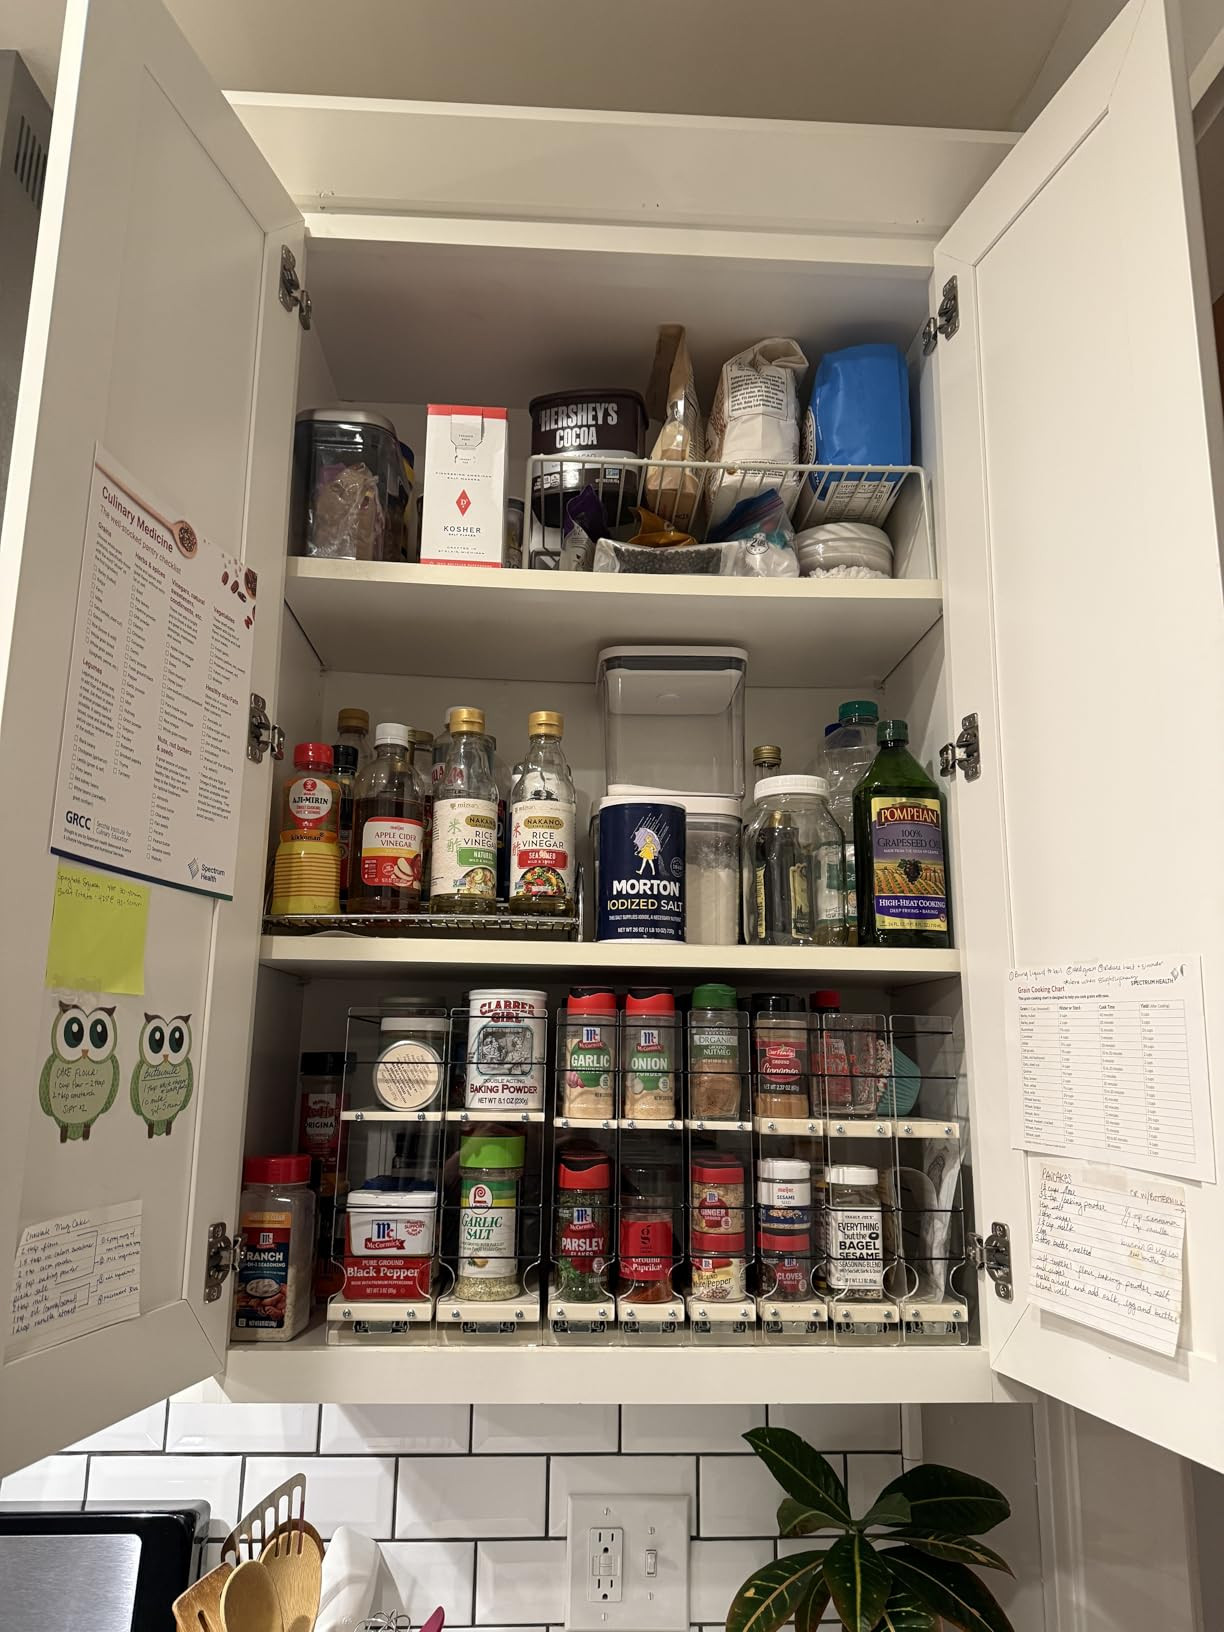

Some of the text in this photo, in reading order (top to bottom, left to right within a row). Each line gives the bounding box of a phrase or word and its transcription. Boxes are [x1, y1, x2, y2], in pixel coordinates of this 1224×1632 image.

[540, 403, 618, 432] HERSHEY'S
[556, 427, 597, 449] COCOA
[102, 486, 174, 553] Culinary Medicine
[444, 525, 481, 534] KOSHER
[143, 542, 158, 559] pantry
[293, 796, 328, 805] AJI-MIRIN
[66, 810, 92, 830] GRCC
[881, 808, 937, 824] POMPEIAN
[399, 833, 417, 841] CIDER
[476, 831, 492, 840] RICE
[901, 829, 923, 838] 100%
[381, 840, 412, 848] VINEGAR
[522, 840, 564, 849] VINEGAR
[878, 838, 927, 848] GRAPESEED
[201, 863, 225, 876] Spectrum
[201, 872, 217, 883] Health
[612, 879, 680, 897] MORTON
[608, 899, 683, 912] IODIZED SALT
[880, 899, 945, 908] HIGH-HEAT COOKING
[1031, 986, 1051, 994] Cooking
[479, 1000, 535, 1016] CLABBER
[491, 1012, 521, 1023] GIRL
[698, 1036, 734, 1044] ORGANIC
[571, 1055, 609, 1067] GARLIC
[631, 1058, 667, 1070] ONION
[763, 1063, 799, 1074] Cinnamon
[470, 1084, 537, 1094] BAKING POWDER
[462, 1213, 503, 1228] GARLIC
[838, 1223, 879, 1232] EVERYTHING
[466, 1228, 493, 1240] SALT
[367, 1241, 401, 1249] McCormick
[562, 1237, 604, 1250] PARSLEY
[840, 1241, 880, 1250] BAGEL
[246, 1252, 283, 1261] RANCH
[347, 1268, 420, 1279] Black Pepper
[632, 1264, 660, 1272] Paprika
[707, 1278, 731, 1288] Pepper
